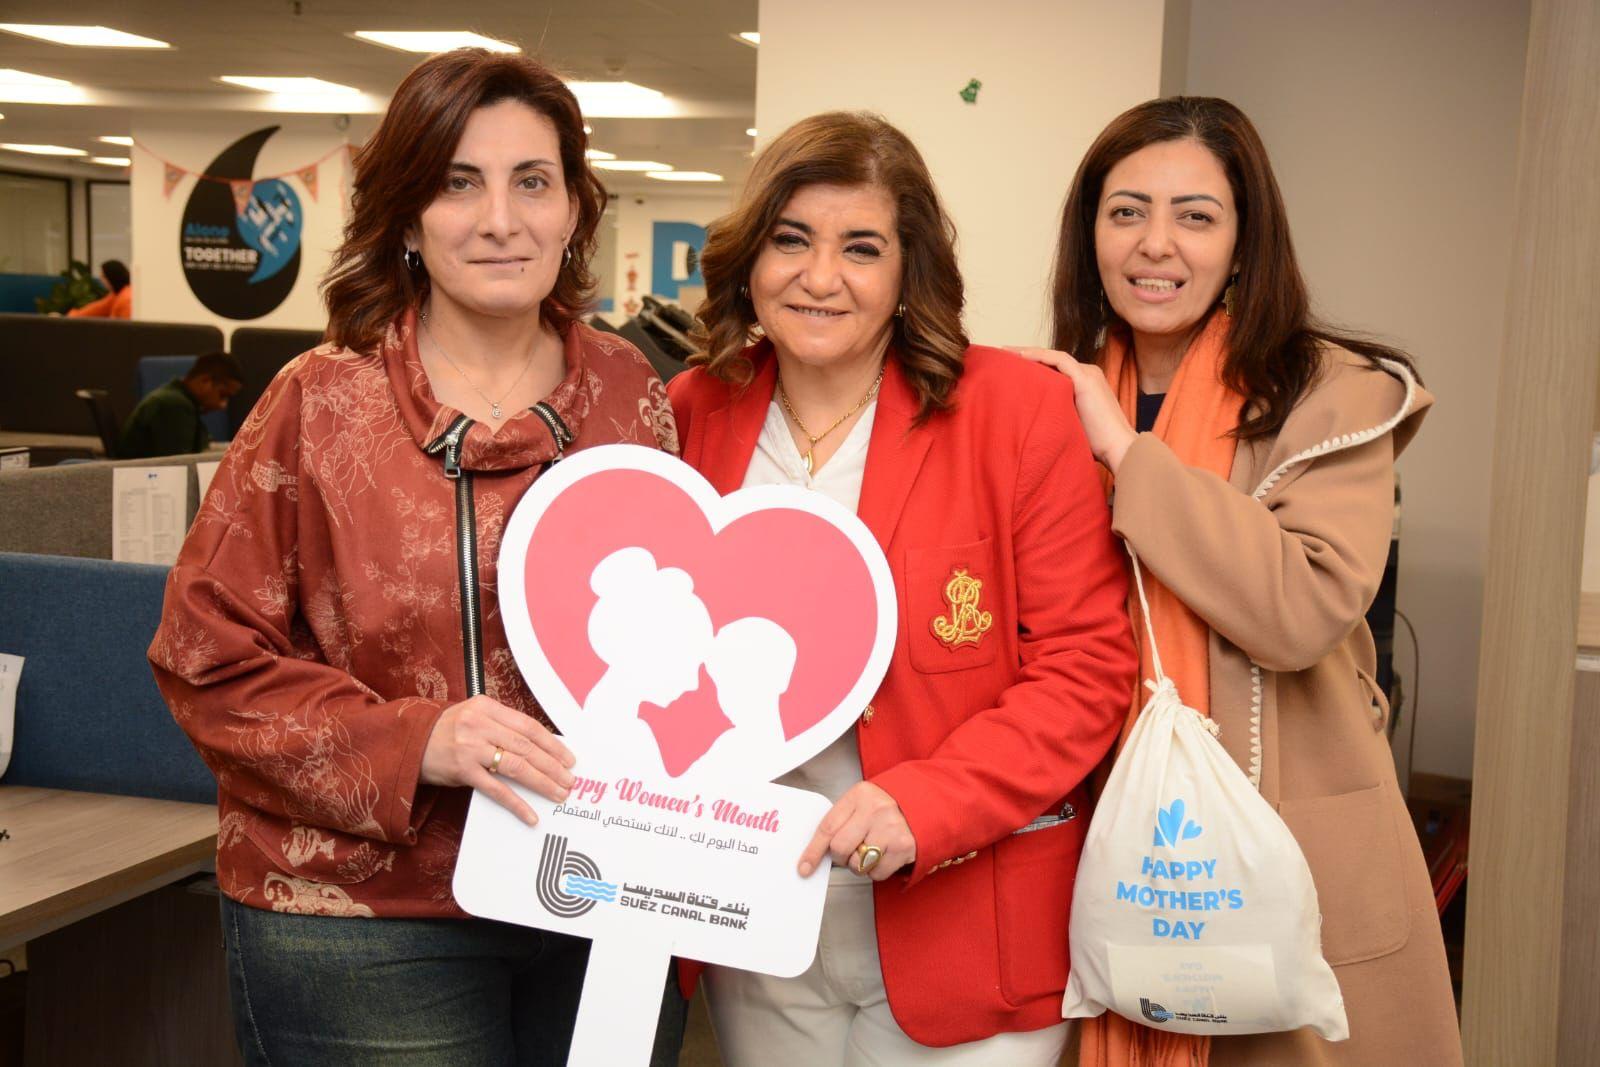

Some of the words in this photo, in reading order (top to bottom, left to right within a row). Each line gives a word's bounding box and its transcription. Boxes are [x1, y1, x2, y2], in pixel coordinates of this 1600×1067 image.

[184, 246, 258, 264] TOGETHER
[570, 775, 608, 804] ppy
[615, 778, 704, 817] Women's
[712, 798, 780, 833] Month
[602, 815, 652, 833] تستحقي
[706, 837, 736, 850] اليوم
[737, 839, 759, 855] هذا
[1141, 856, 1217, 880] HAPPY
[622, 881, 686, 904] السويس
[686, 892, 719, 910] قناة
[1116, 881, 1243, 911] MOTHER'S
[620, 895, 658, 912] SUEZ
[661, 903, 706, 922] CANAL
[709, 914, 748, 931] BANK
[719, 902, 750, 920] بنك
[1152, 918, 1206, 940] DAY
